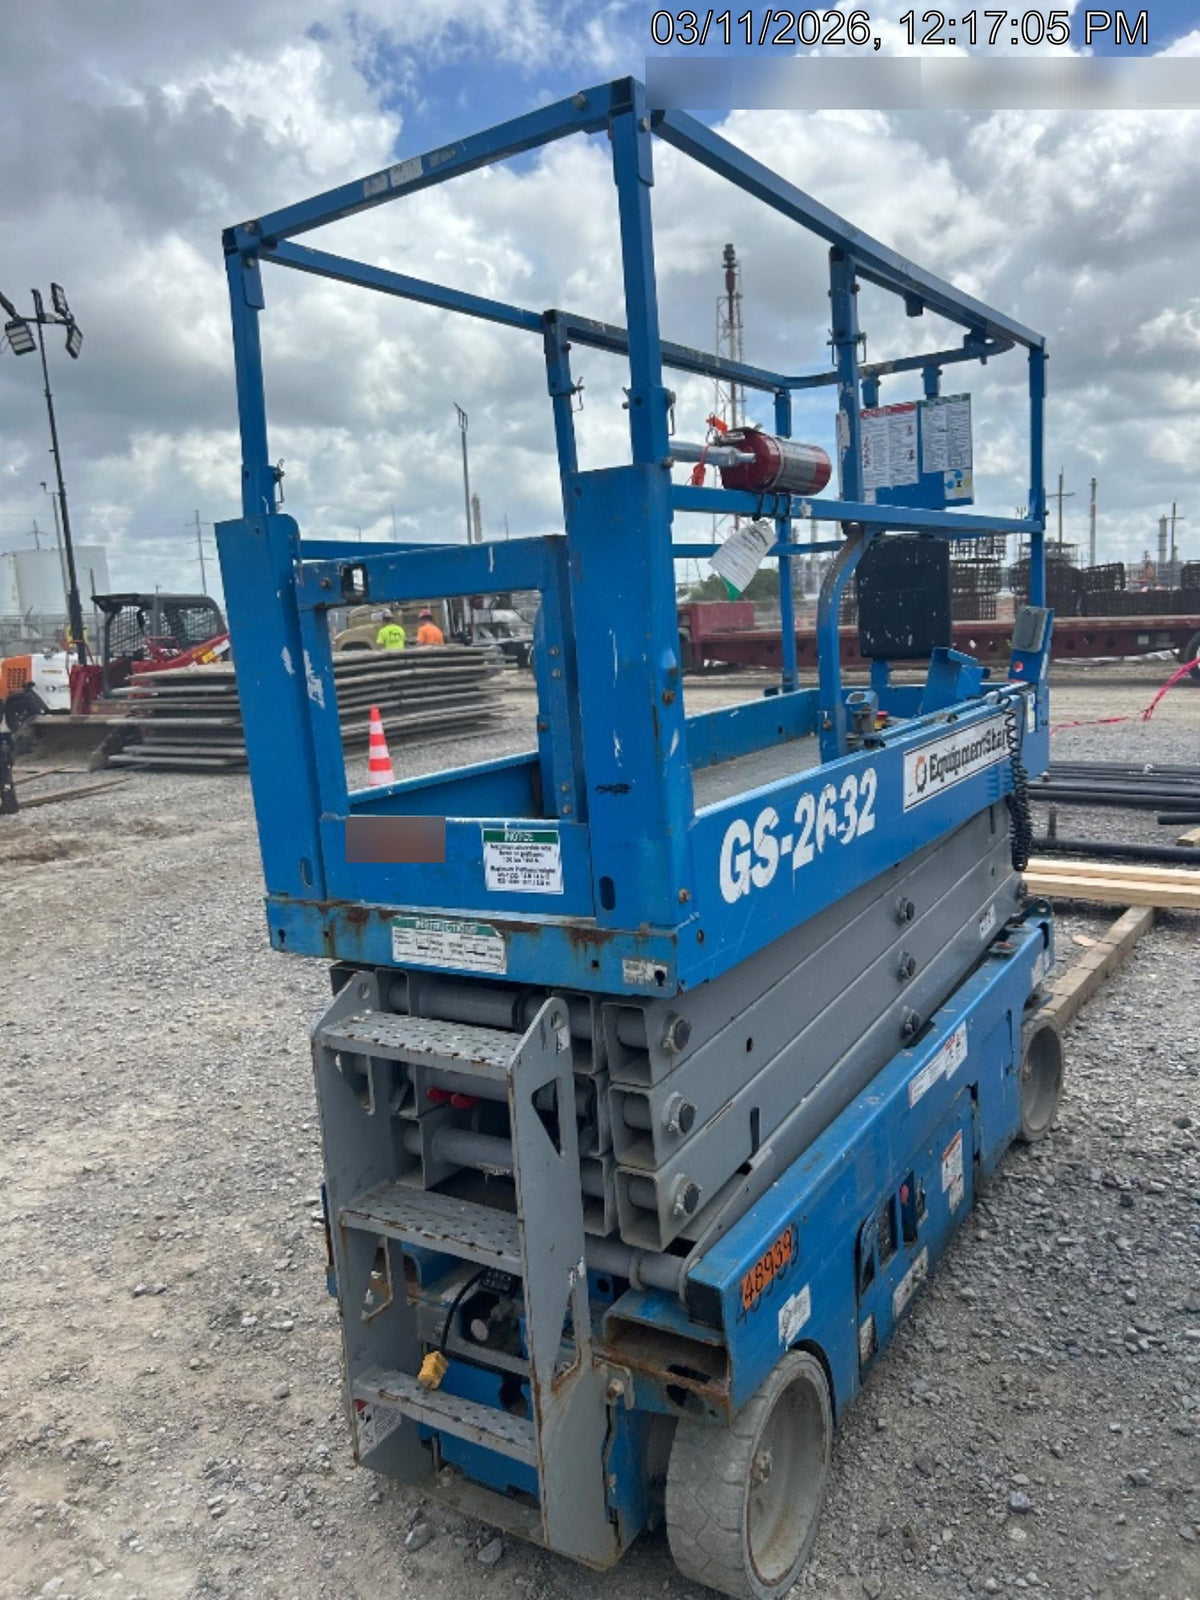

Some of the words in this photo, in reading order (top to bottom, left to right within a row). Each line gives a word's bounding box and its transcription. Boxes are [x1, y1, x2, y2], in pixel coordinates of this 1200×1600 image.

[929, 726, 1012, 783] EquipmentShar
[719, 767, 878, 904] GS-2632
[743, 1228, 794, 1302] 48939
